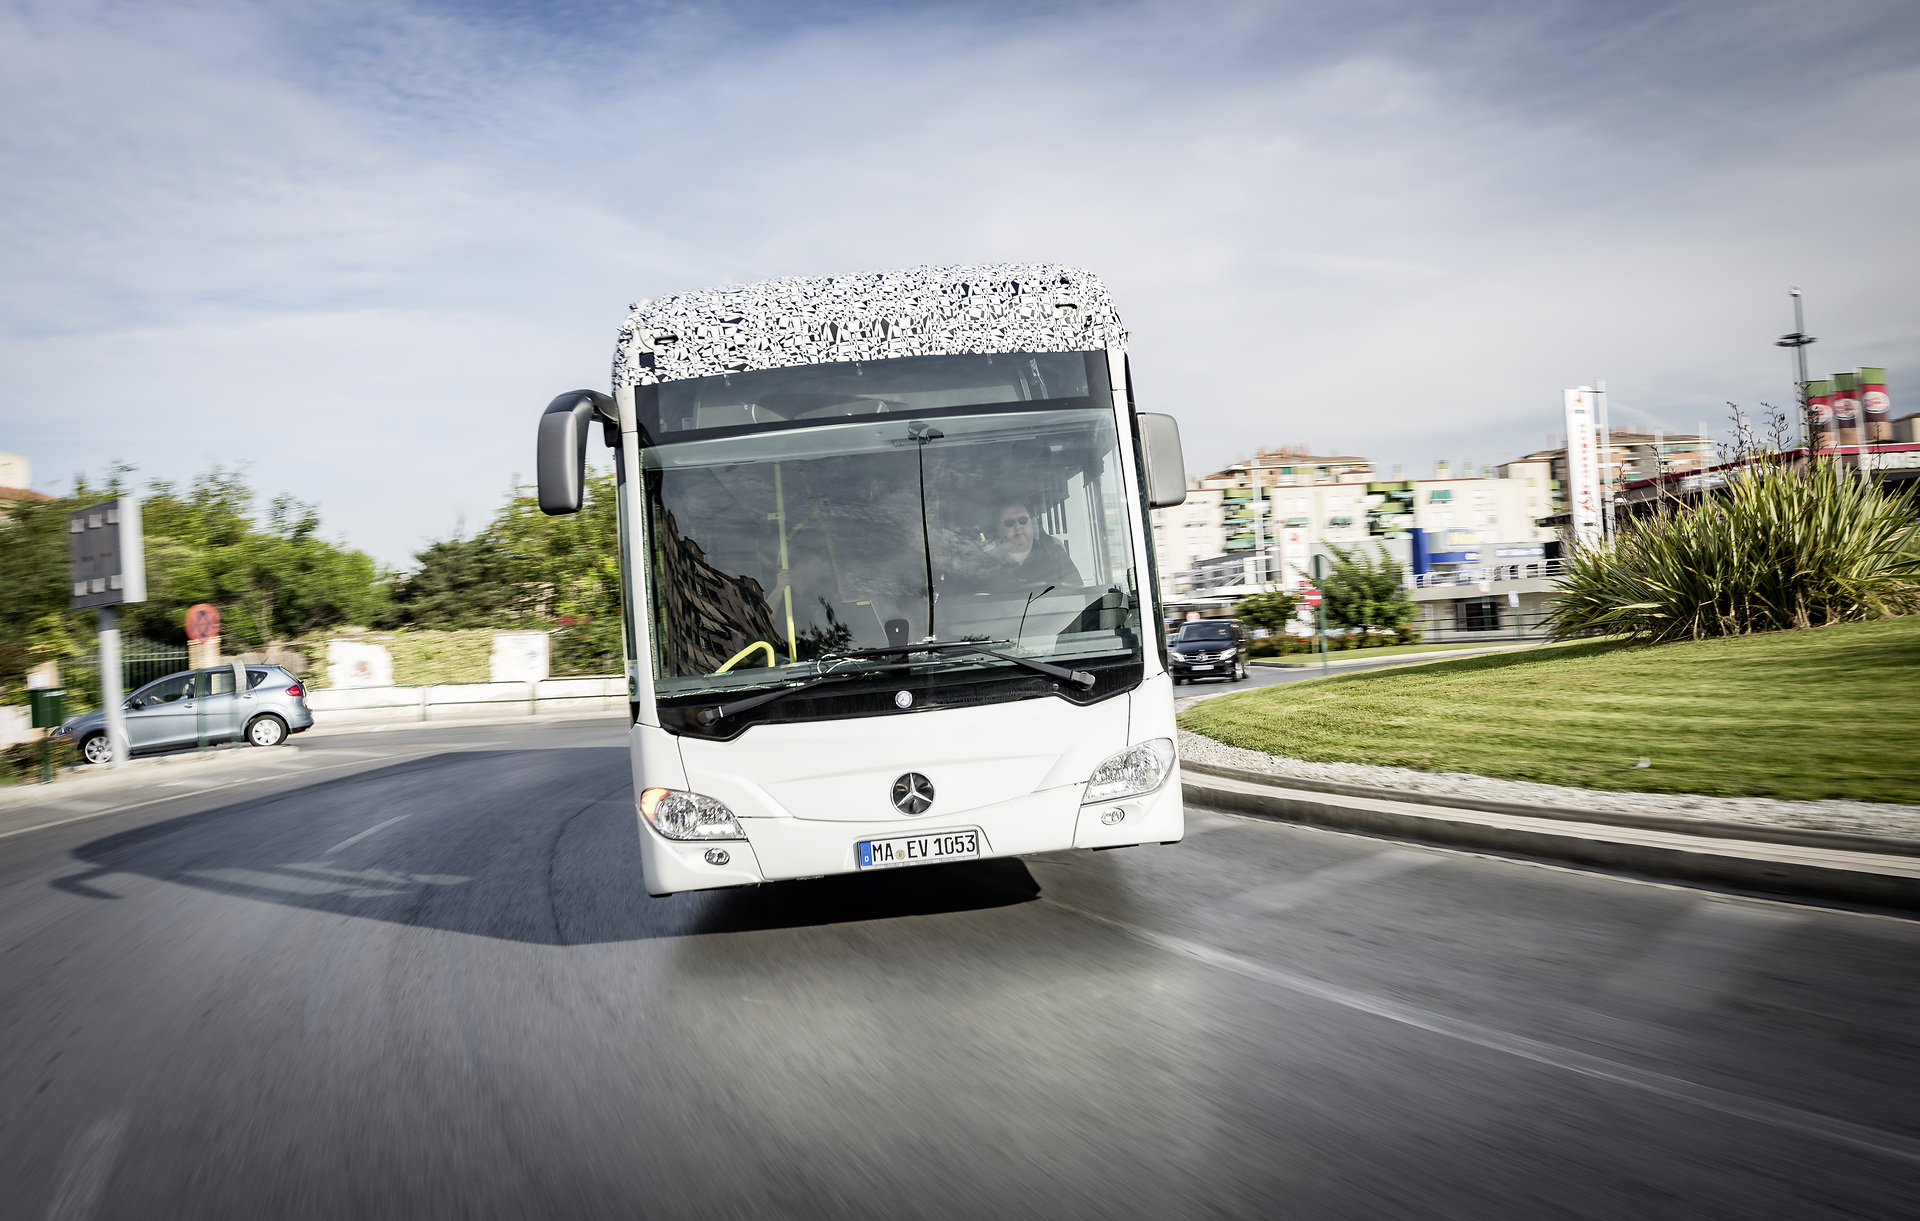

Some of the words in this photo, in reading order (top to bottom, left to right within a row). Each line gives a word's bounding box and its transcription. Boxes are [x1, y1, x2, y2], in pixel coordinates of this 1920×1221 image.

[872, 843, 894, 862] MA
[906, 839, 928, 859] EV
[933, 835, 976, 856] 1053
